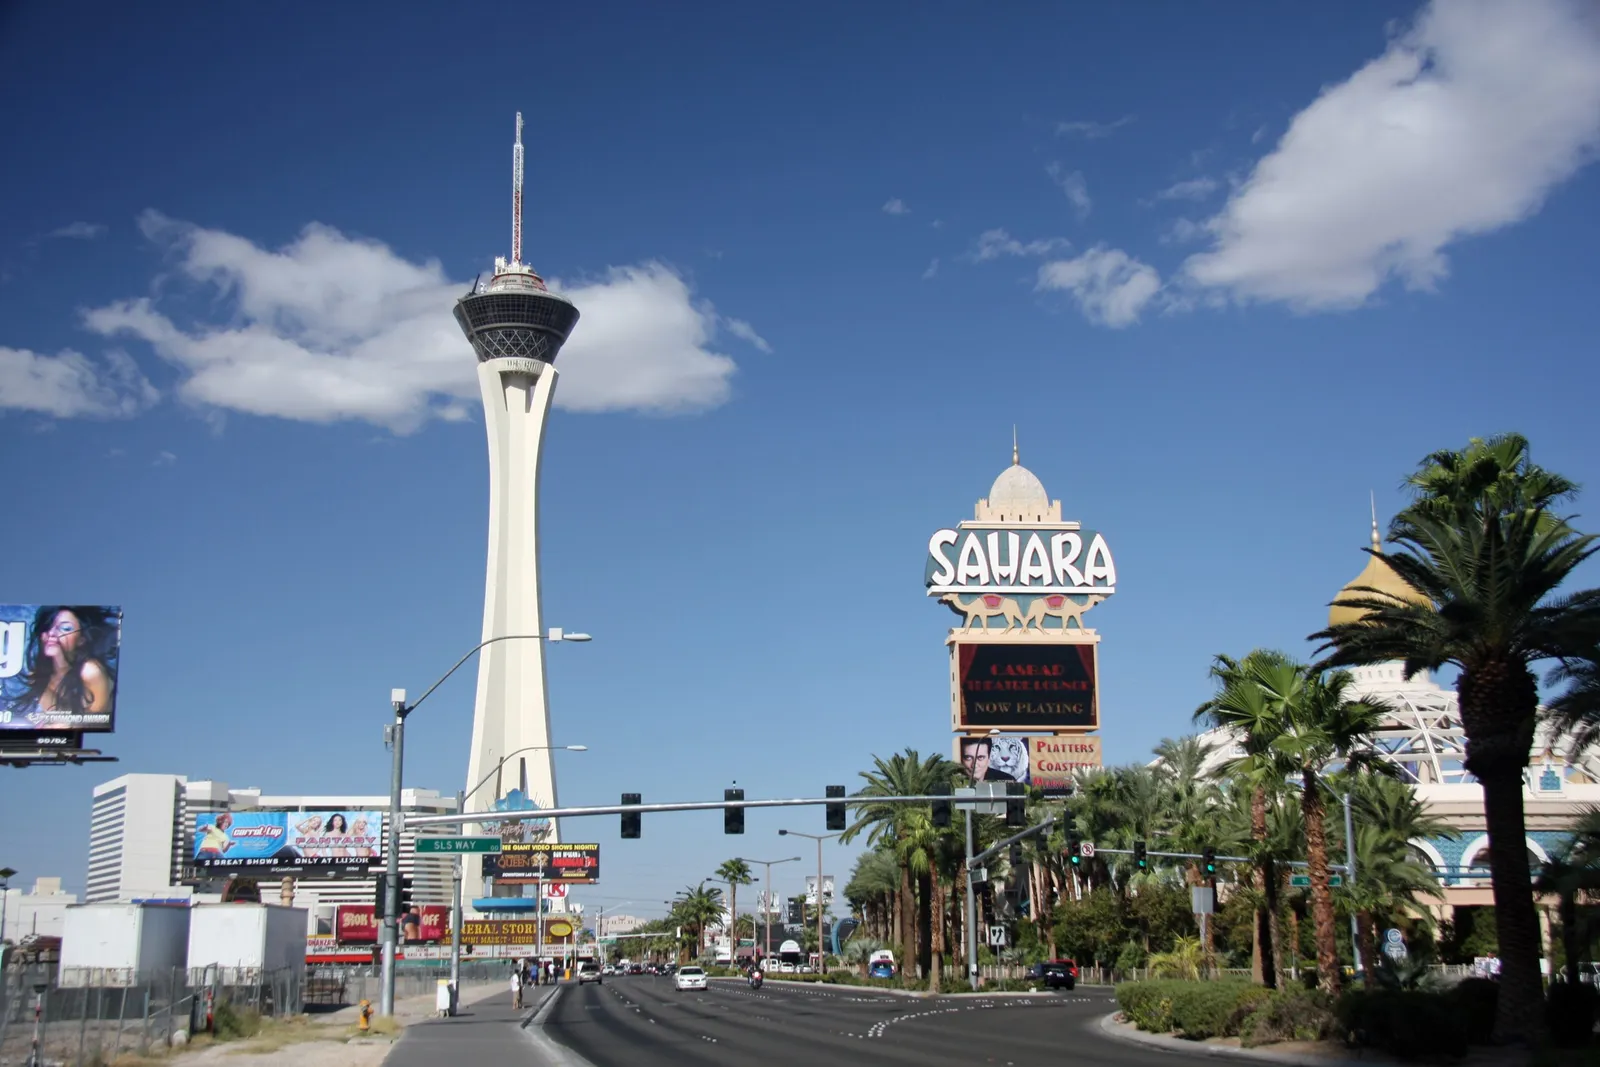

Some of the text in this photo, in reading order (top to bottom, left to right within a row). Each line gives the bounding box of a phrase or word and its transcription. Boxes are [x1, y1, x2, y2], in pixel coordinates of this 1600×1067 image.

[928, 528, 1116, 586] SAHARA
[974, 702, 1084, 714] NOW PLAYING
[50, 714, 82, 723] DIAMOND
[1036, 740, 1094, 753] PLATTERS
[296, 836, 377, 845] FANTASY
[434, 841, 453, 850] SLS
[455, 840, 476, 850] WAY
[574, 843, 598, 851] NIGHTLY
[214, 858, 243, 866] GREAT
[246, 858, 279, 866] SHOWS
[294, 857, 318, 865] ONLY
[321, 857, 333, 865] AT
[498, 857, 531, 869] QUEEN
